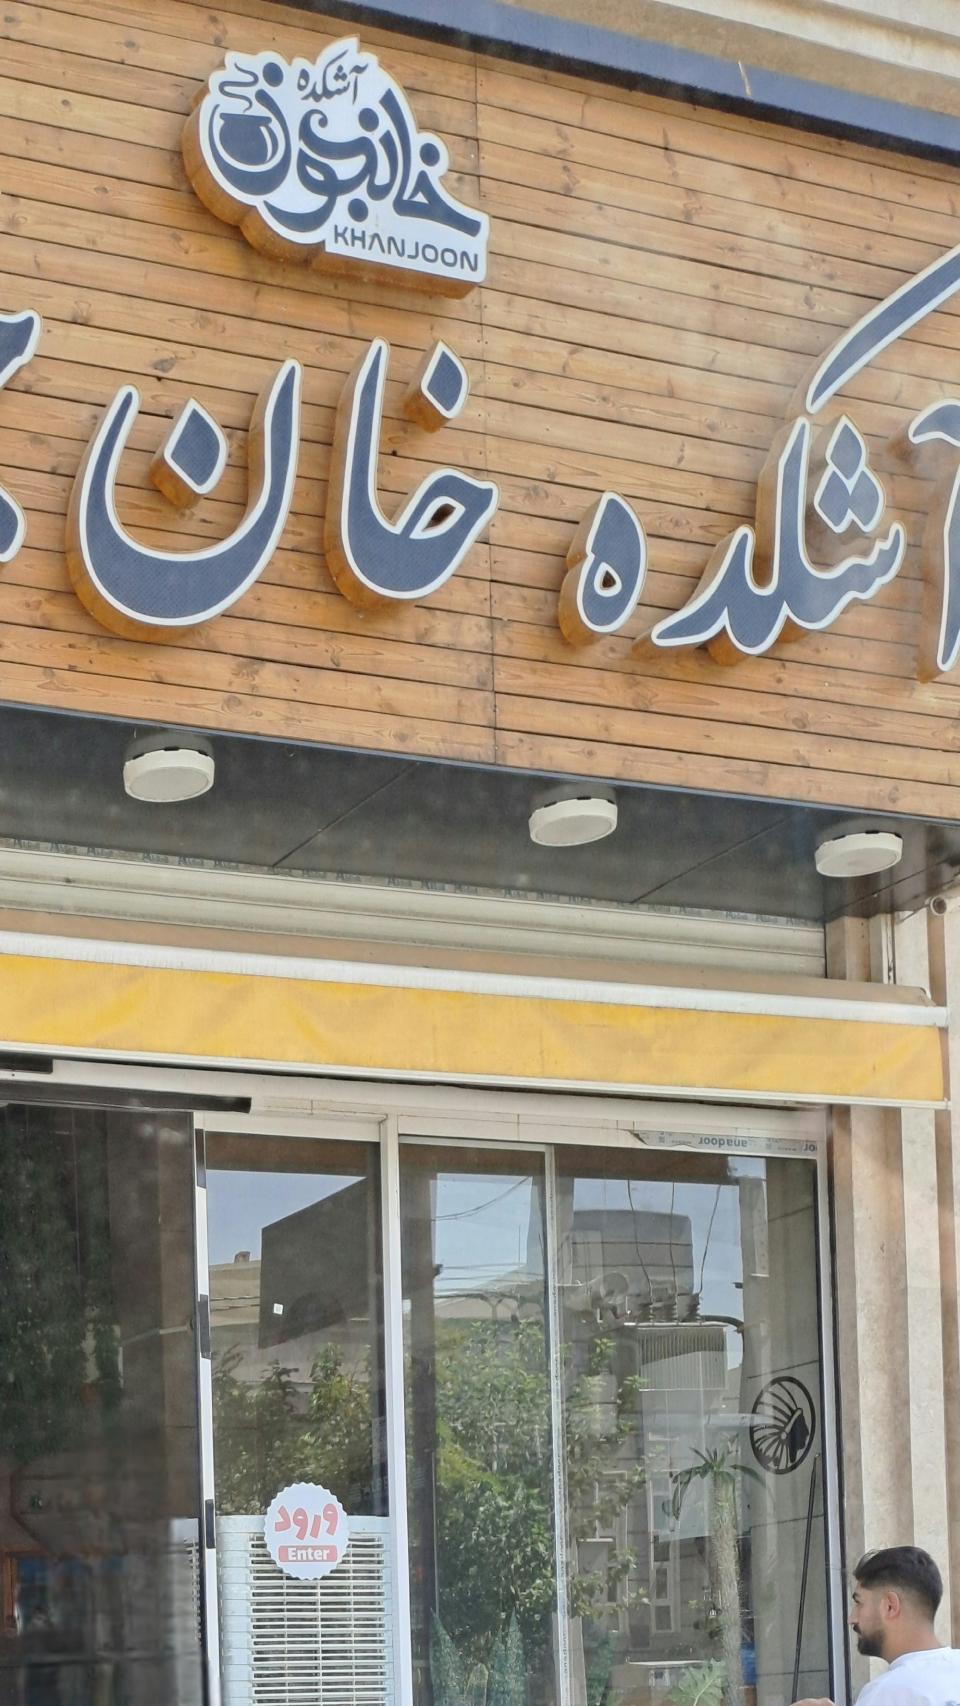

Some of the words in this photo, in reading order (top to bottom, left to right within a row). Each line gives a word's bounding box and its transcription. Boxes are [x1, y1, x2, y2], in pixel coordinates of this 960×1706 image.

[334, 225, 478, 272] KHANJOON
[79, 336, 500, 627] خان
[275, 1504, 338, 1540] ورود
[288, 1547, 330, 1560] Enter
